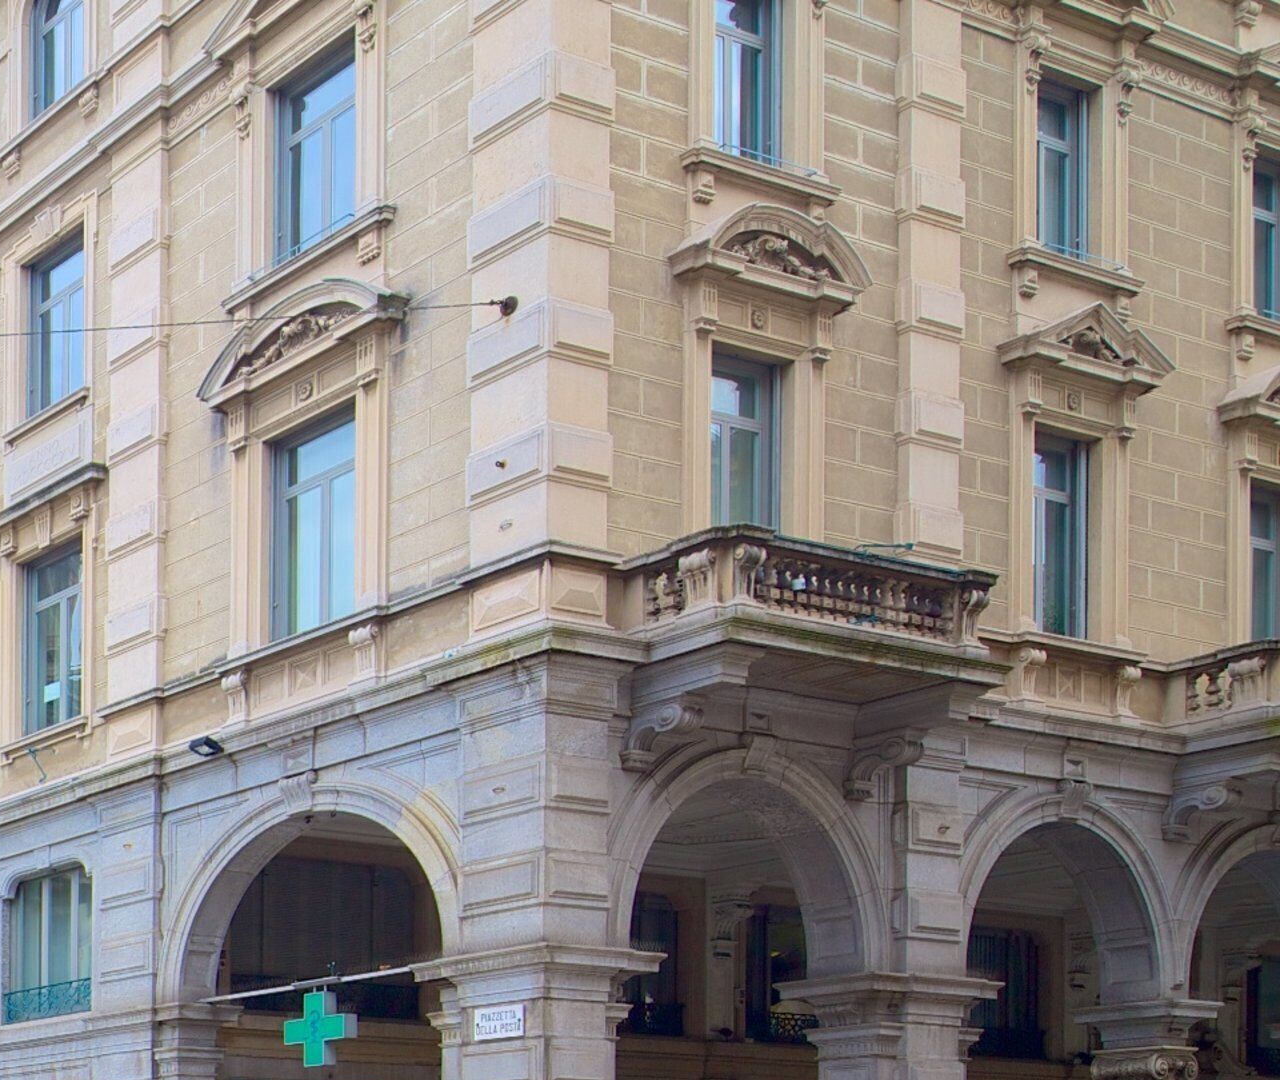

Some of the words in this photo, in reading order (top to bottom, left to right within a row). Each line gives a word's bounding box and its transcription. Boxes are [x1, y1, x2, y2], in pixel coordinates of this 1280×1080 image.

[481, 1010, 516, 1022] PIAZZETTA
[476, 1024, 497, 1035] DELLA
[500, 1021, 521, 1033] POSTA
